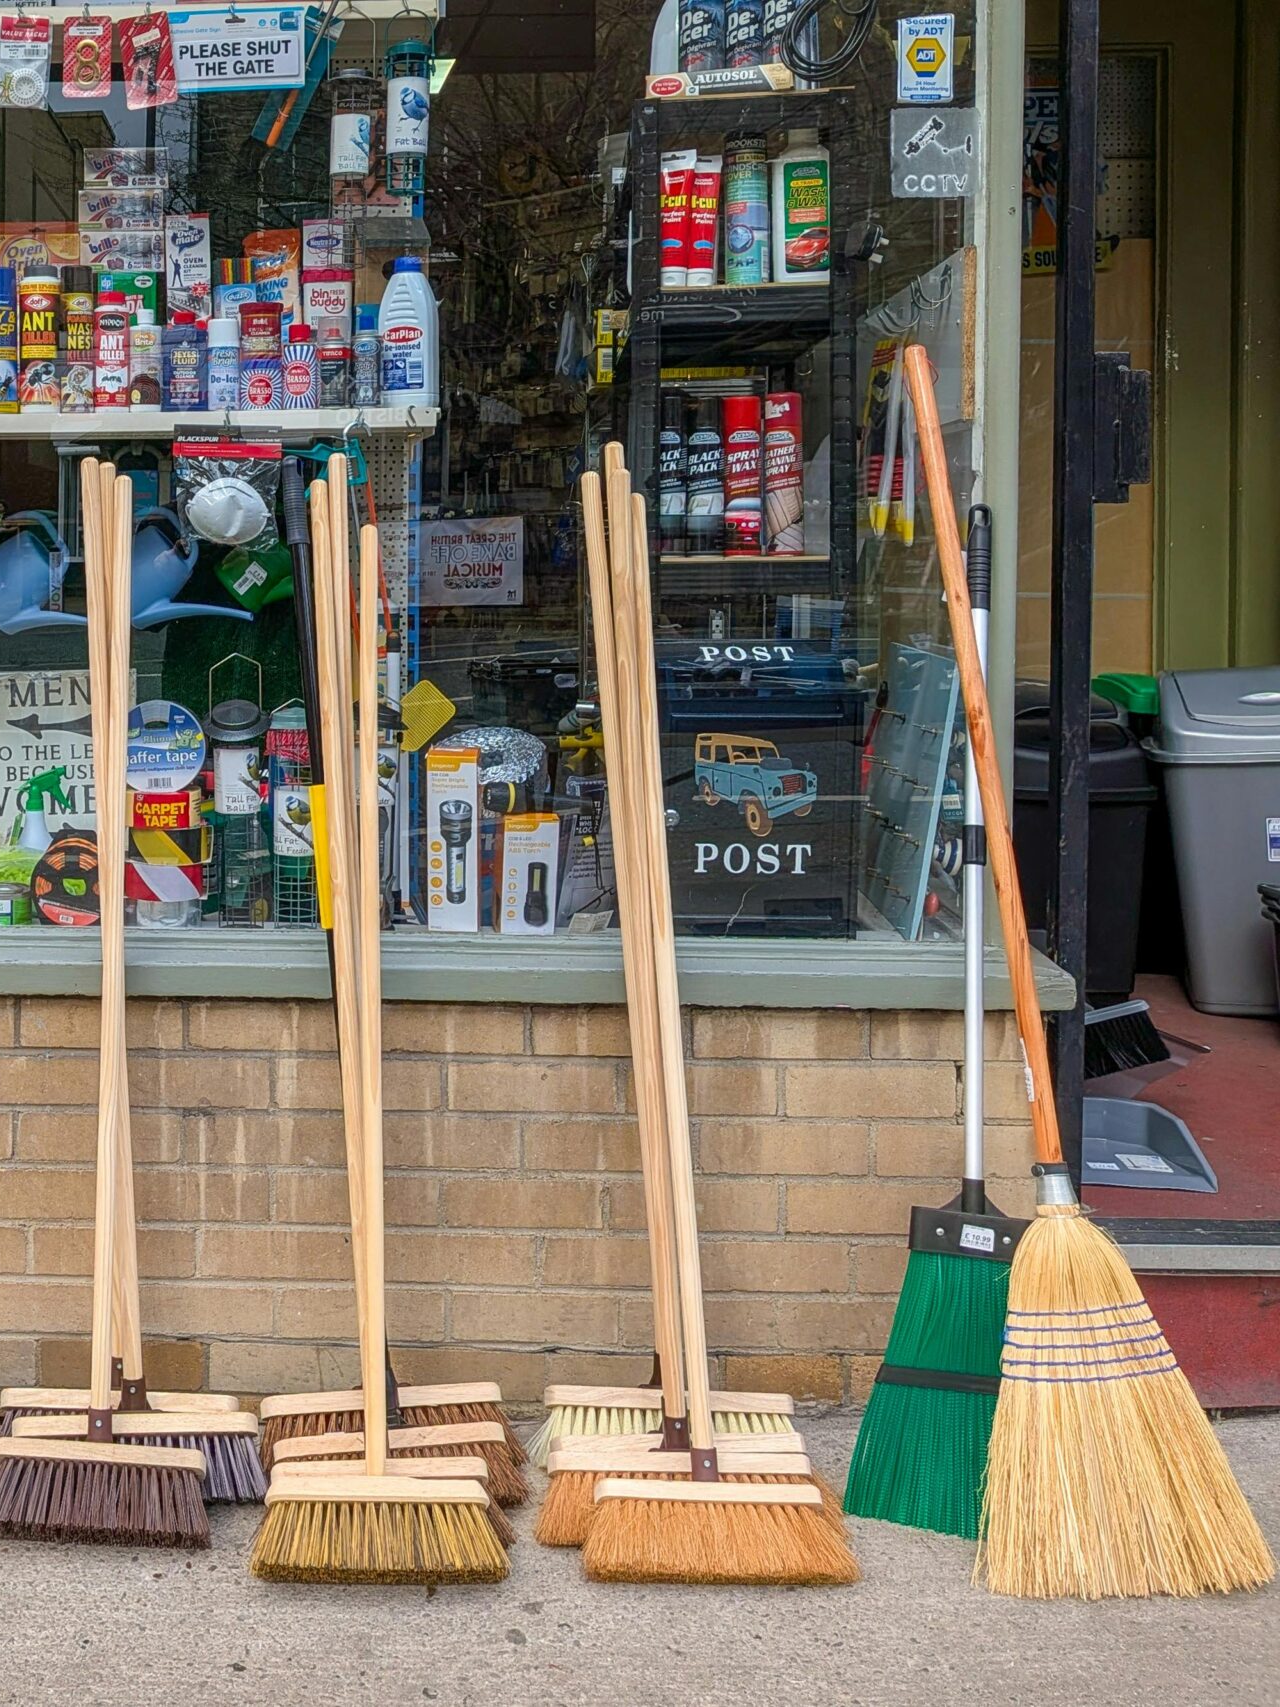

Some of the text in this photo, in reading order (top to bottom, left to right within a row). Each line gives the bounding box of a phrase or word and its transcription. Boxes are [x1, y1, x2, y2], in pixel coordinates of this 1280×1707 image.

[905, 17, 948, 25] Secured
[908, 27, 945, 36] by ADT
[179, 40, 292, 59] PLEASE SHUT
[916, 50, 935, 61] ADT
[195, 59, 275, 77] THE GATE
[695, 70, 757, 84] AUTOSOL
[903, 174, 969, 193] CCTV
[790, 187, 827, 198] WASH
[87, 195, 118, 213] brillo
[797, 197, 826, 207] WAX
[175, 235, 202, 246] mate
[176, 229, 200, 238] Oven
[6, 244, 43, 259] Oven
[88, 237, 119, 254] brillo
[256, 277, 289, 292] AKING
[311, 288, 330, 300] bin
[309, 296, 346, 310] buddy
[8, 311, 17, 323] &
[22, 312, 55, 332] ANT
[22, 332, 56, 345] KILLER
[384, 329, 422, 340] CarPlan
[99, 335, 125, 350] ANT
[384, 341, 421, 351] De-ionised
[99, 350, 125, 361] KILLER
[172, 350, 197, 358] JEYES
[172, 357, 197, 365] FLUID
[392, 350, 413, 359] water
[286, 374, 310, 383] BRASSO
[249, 386, 272, 395] BRASSO
[687, 449, 721, 465] BLACK
[727, 449, 760, 464] SPRAY
[765, 445, 796, 459] EATHER
[689, 462, 719, 476] PACK
[730, 460, 758, 474] WAX
[699, 646, 794, 662] POST
[8, 675, 92, 709] MEN
[22, 744, 61, 761] THE
[71, 744, 93, 760] LE
[166, 750, 198, 765] tape
[225, 795, 245, 804] Tall
[135, 801, 187, 815] CARPET
[225, 803, 247, 813] Ball
[143, 814, 178, 828] TAPE
[284, 837, 299, 846] Fat
[694, 843, 812, 875] POST
[964, 1231, 992, 1244] £ 10.99
